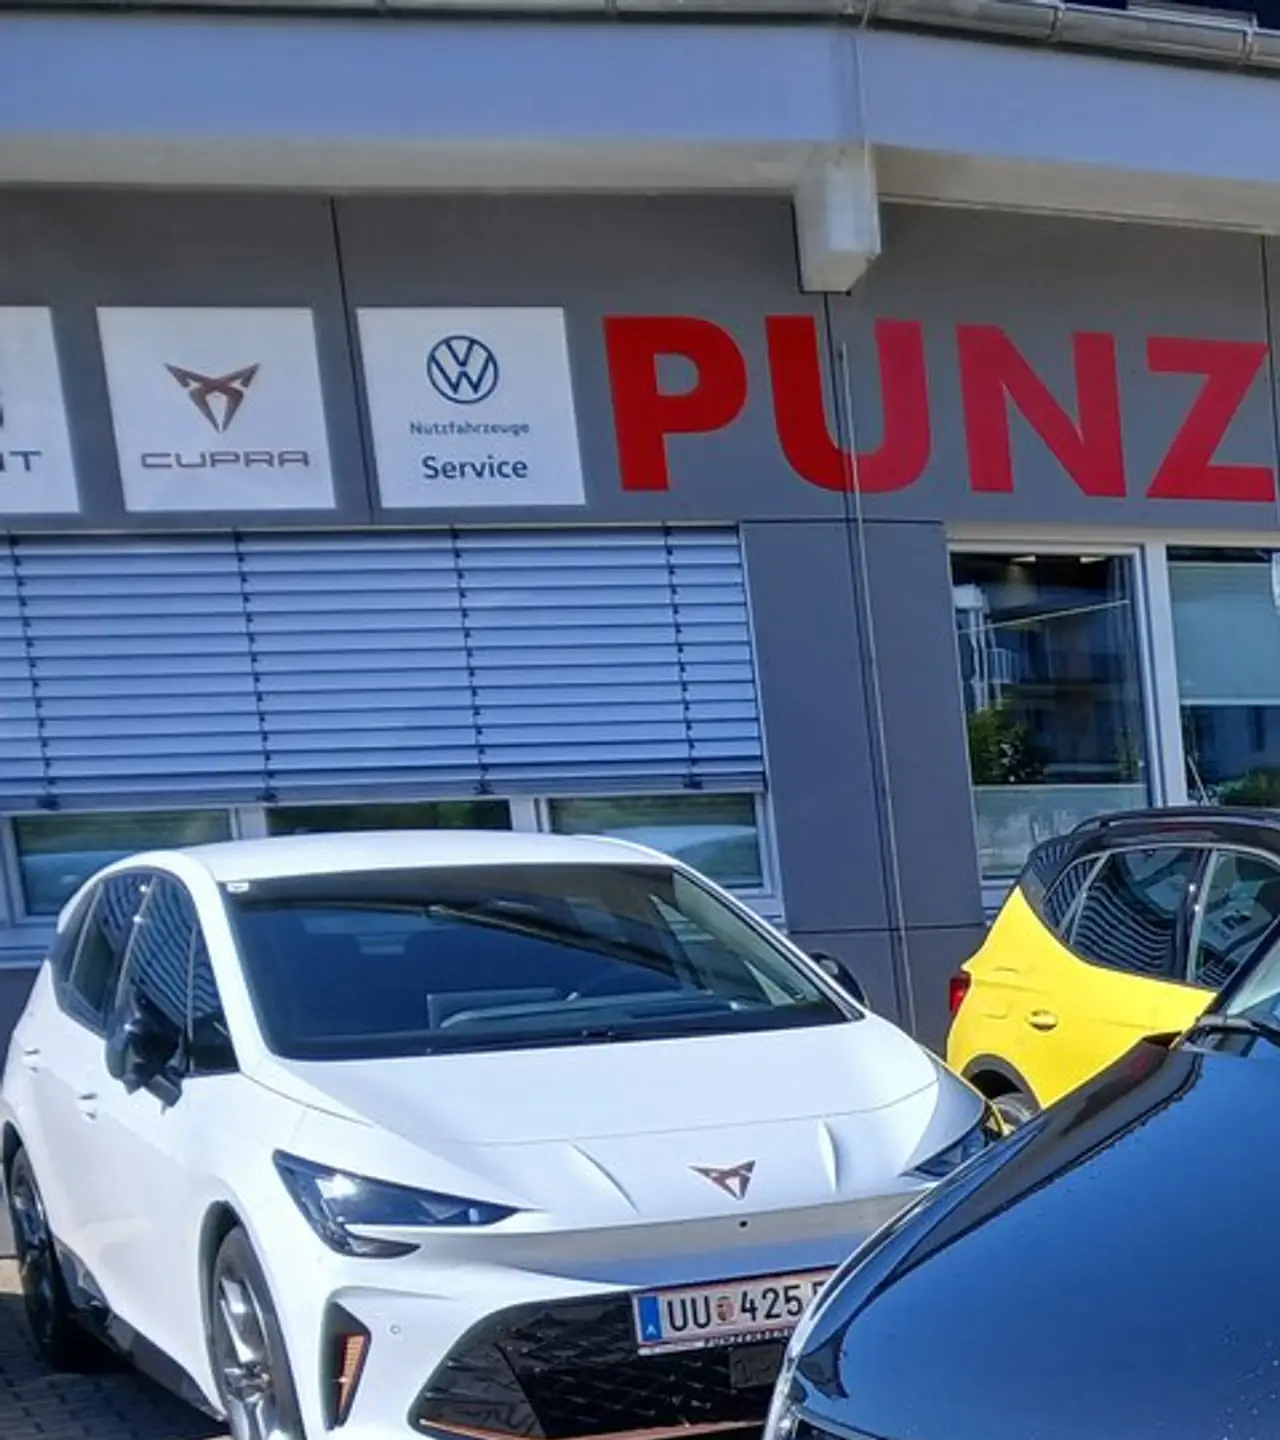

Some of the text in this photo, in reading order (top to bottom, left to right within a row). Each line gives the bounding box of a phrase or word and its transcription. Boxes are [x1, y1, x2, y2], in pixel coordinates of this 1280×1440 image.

[409, 421, 530, 437] Nutzfahrzeuge
[141, 451, 309, 468] CUPRA
[421, 453, 529, 479] Service
[667, 1295, 712, 1332] UU
